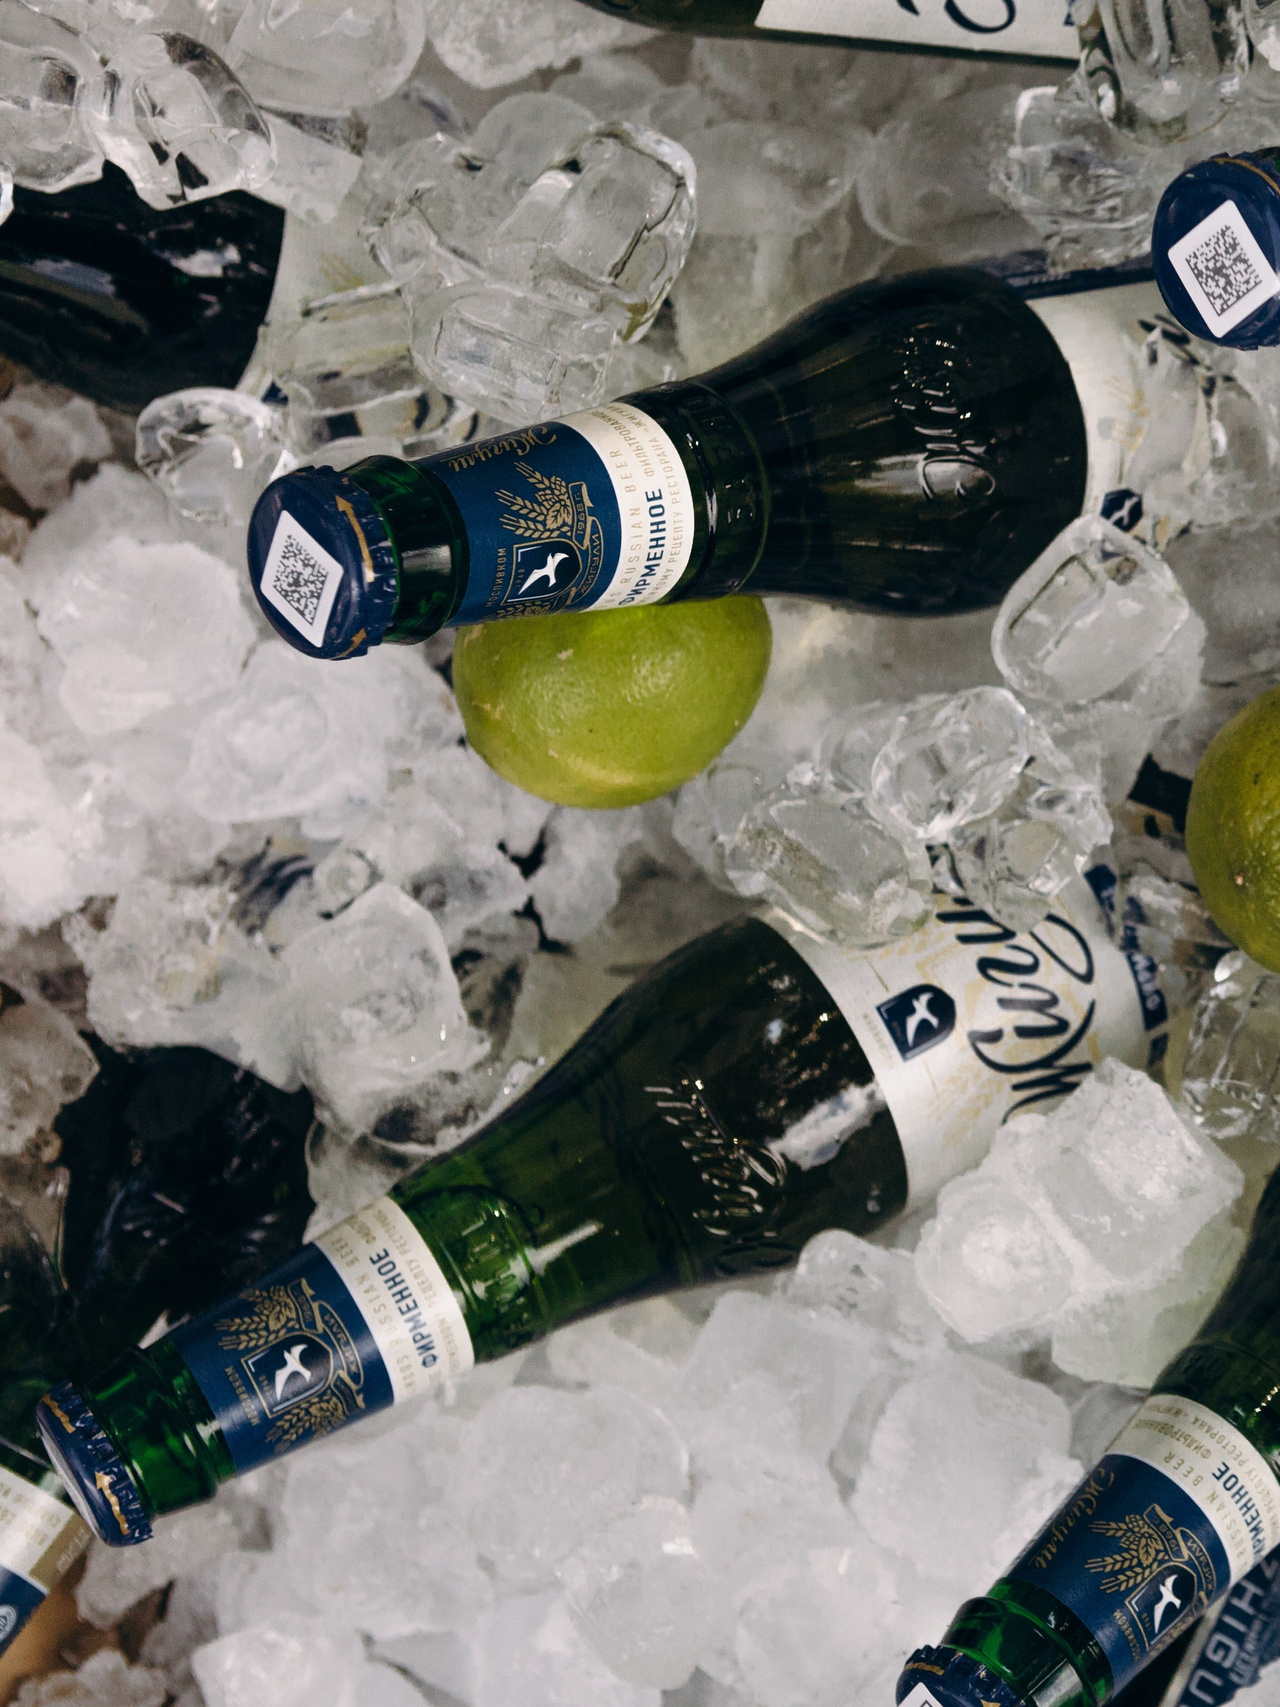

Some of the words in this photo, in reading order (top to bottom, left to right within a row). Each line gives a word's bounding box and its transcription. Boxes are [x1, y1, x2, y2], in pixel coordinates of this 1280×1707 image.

[608, 448, 636, 492] BEER
[647, 435, 681, 504] РЕСТОРАНА
[576, 502, 585, 535] 1968
[618, 487, 667, 605] ФИРМЕННОЕ
[621, 505, 644, 583] RUSSIAN
[666, 510, 684, 563] РЕЦЕПТУ
[485, 547, 506, 607] МОСПИВКОМ
[578, 532, 600, 593] ЖИГУЛИ
[934, 896, 1094, 1125] Жигу
[367, 1246, 438, 1370] ФИРМЕННОЕ
[1162, 1450, 1204, 1487] BEER
[1189, 1415, 1249, 1468] РЕСТОРАНА
[1156, 1522, 1180, 1552] 1968
